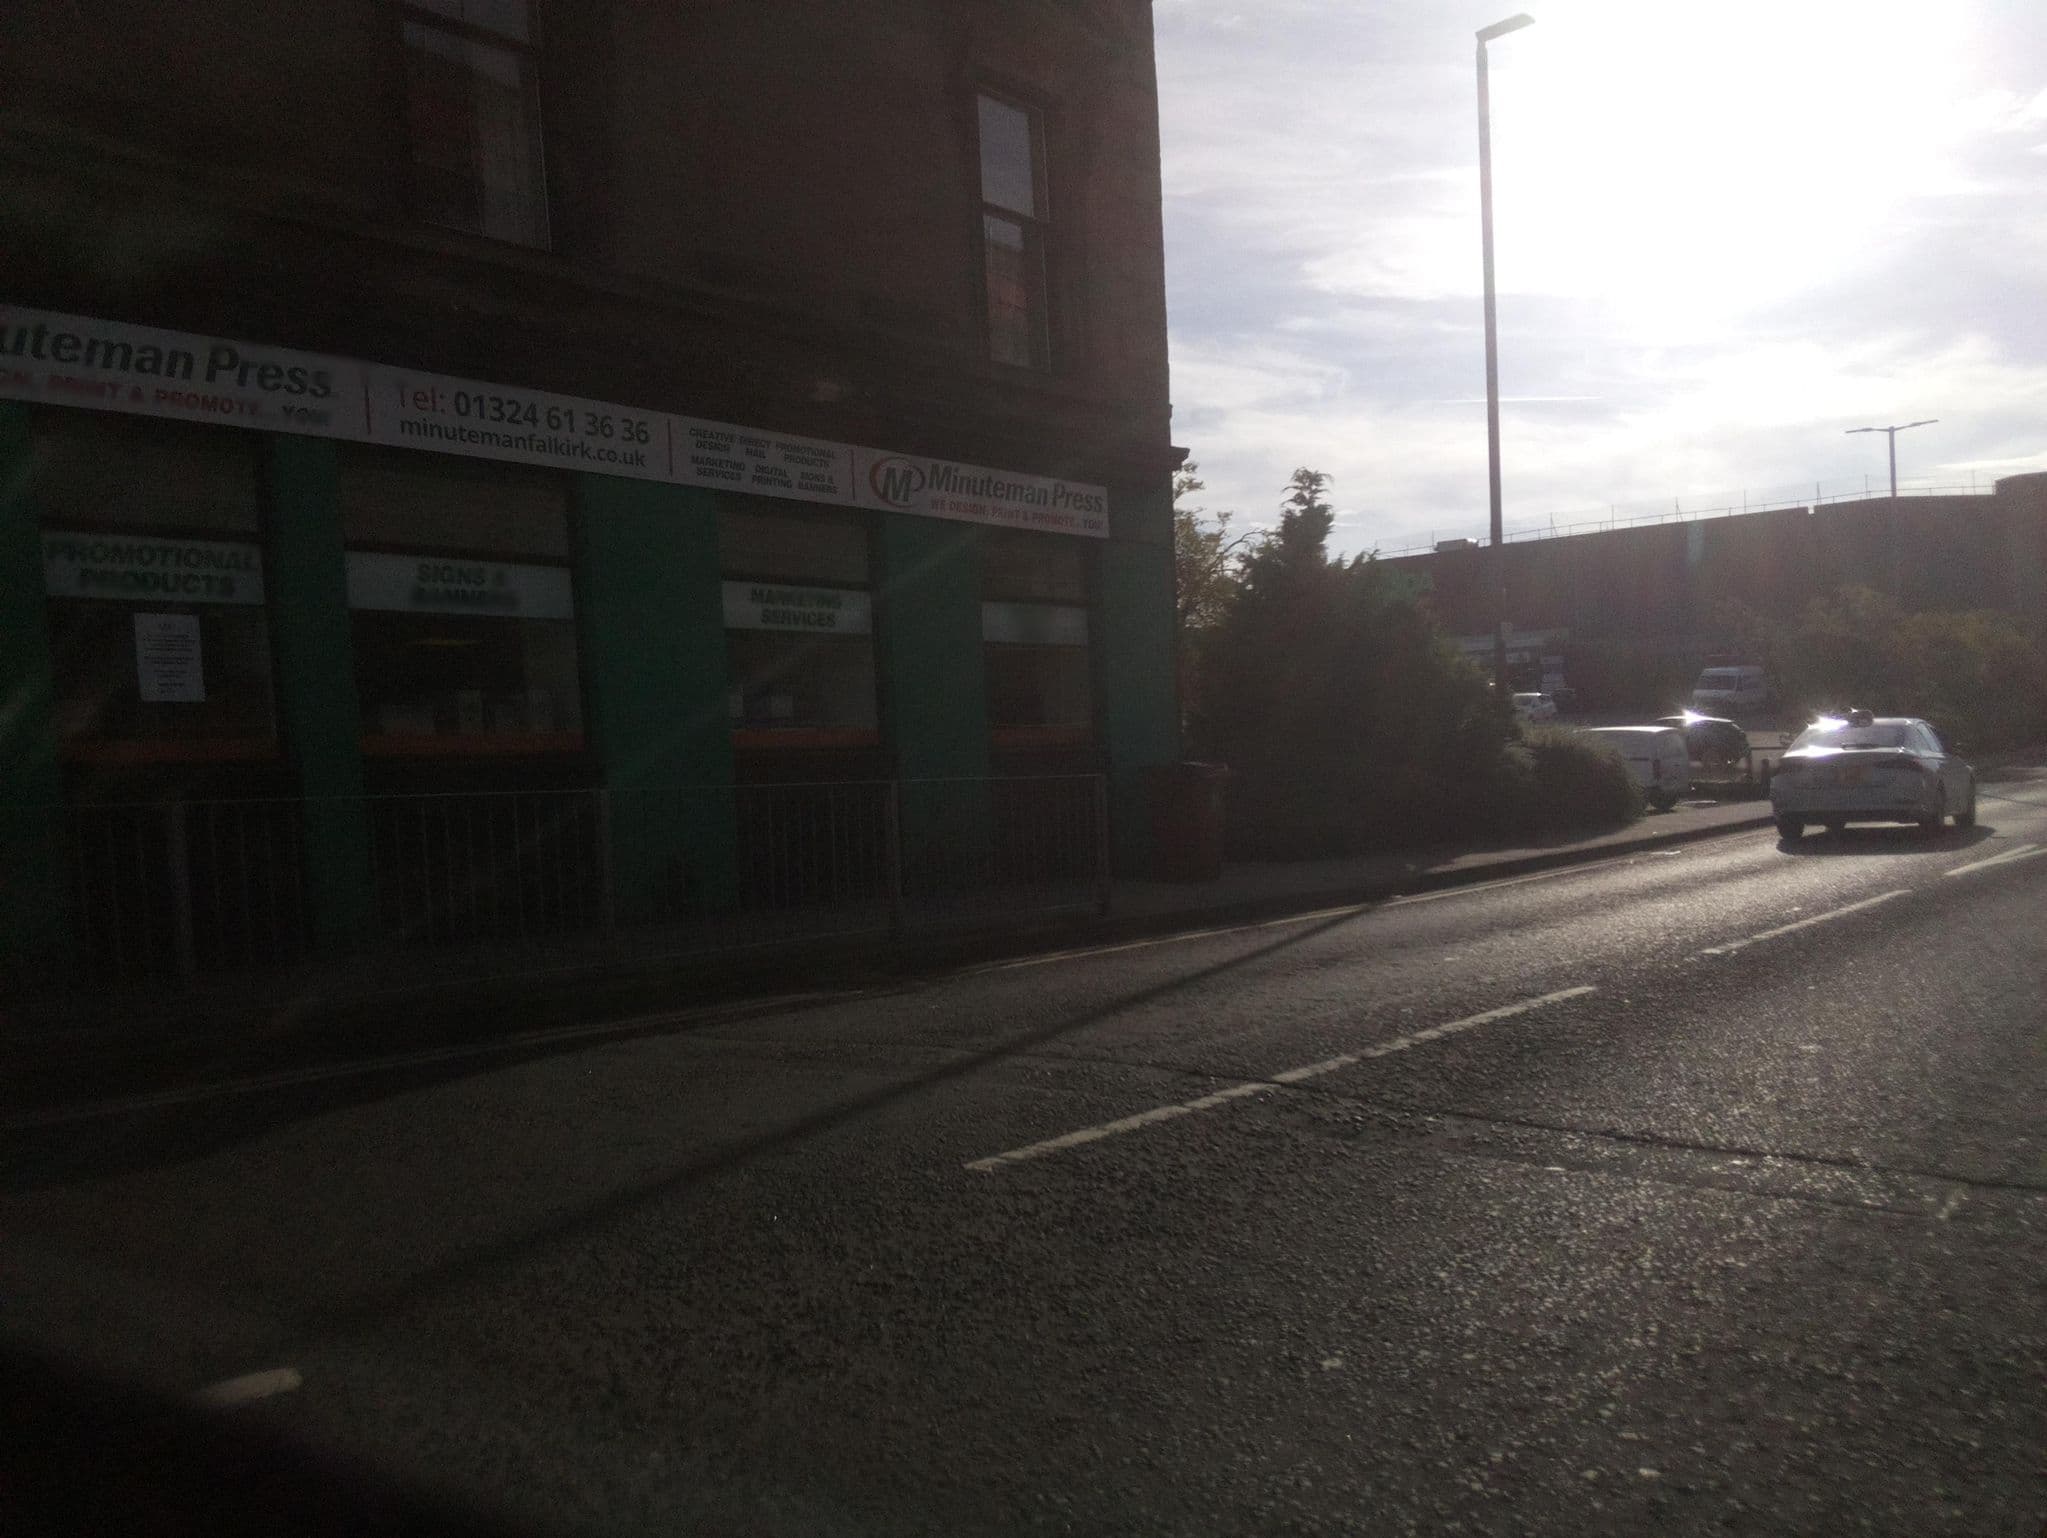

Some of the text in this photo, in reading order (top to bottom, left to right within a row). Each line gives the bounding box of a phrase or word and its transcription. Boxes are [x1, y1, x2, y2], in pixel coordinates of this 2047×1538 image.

[205, 344, 332, 398] Press
[398, 382, 650, 445] Tel: 01324 61 36 36
[400, 417, 647, 467] minutemanfalkirk.co.uk
[689, 428, 735, 443] CREATIVE
[695, 440, 731, 452] DESIGN
[745, 447, 767, 459] MAIL
[775, 441, 835, 459] PROMOTIONAL
[691, 455, 746, 472] MARKETING
[784, 453, 831, 468] PRODUCTS
[696, 467, 742, 481] SERVICES
[755, 464, 788, 478] DIGITAL
[752, 475, 793, 489] PRINTING
[928, 463, 1104, 513] Minuteman Press
[931, 499, 946, 511] WE
[416, 563, 487, 586] SIGNS
[760, 608, 836, 627] SERVICES
